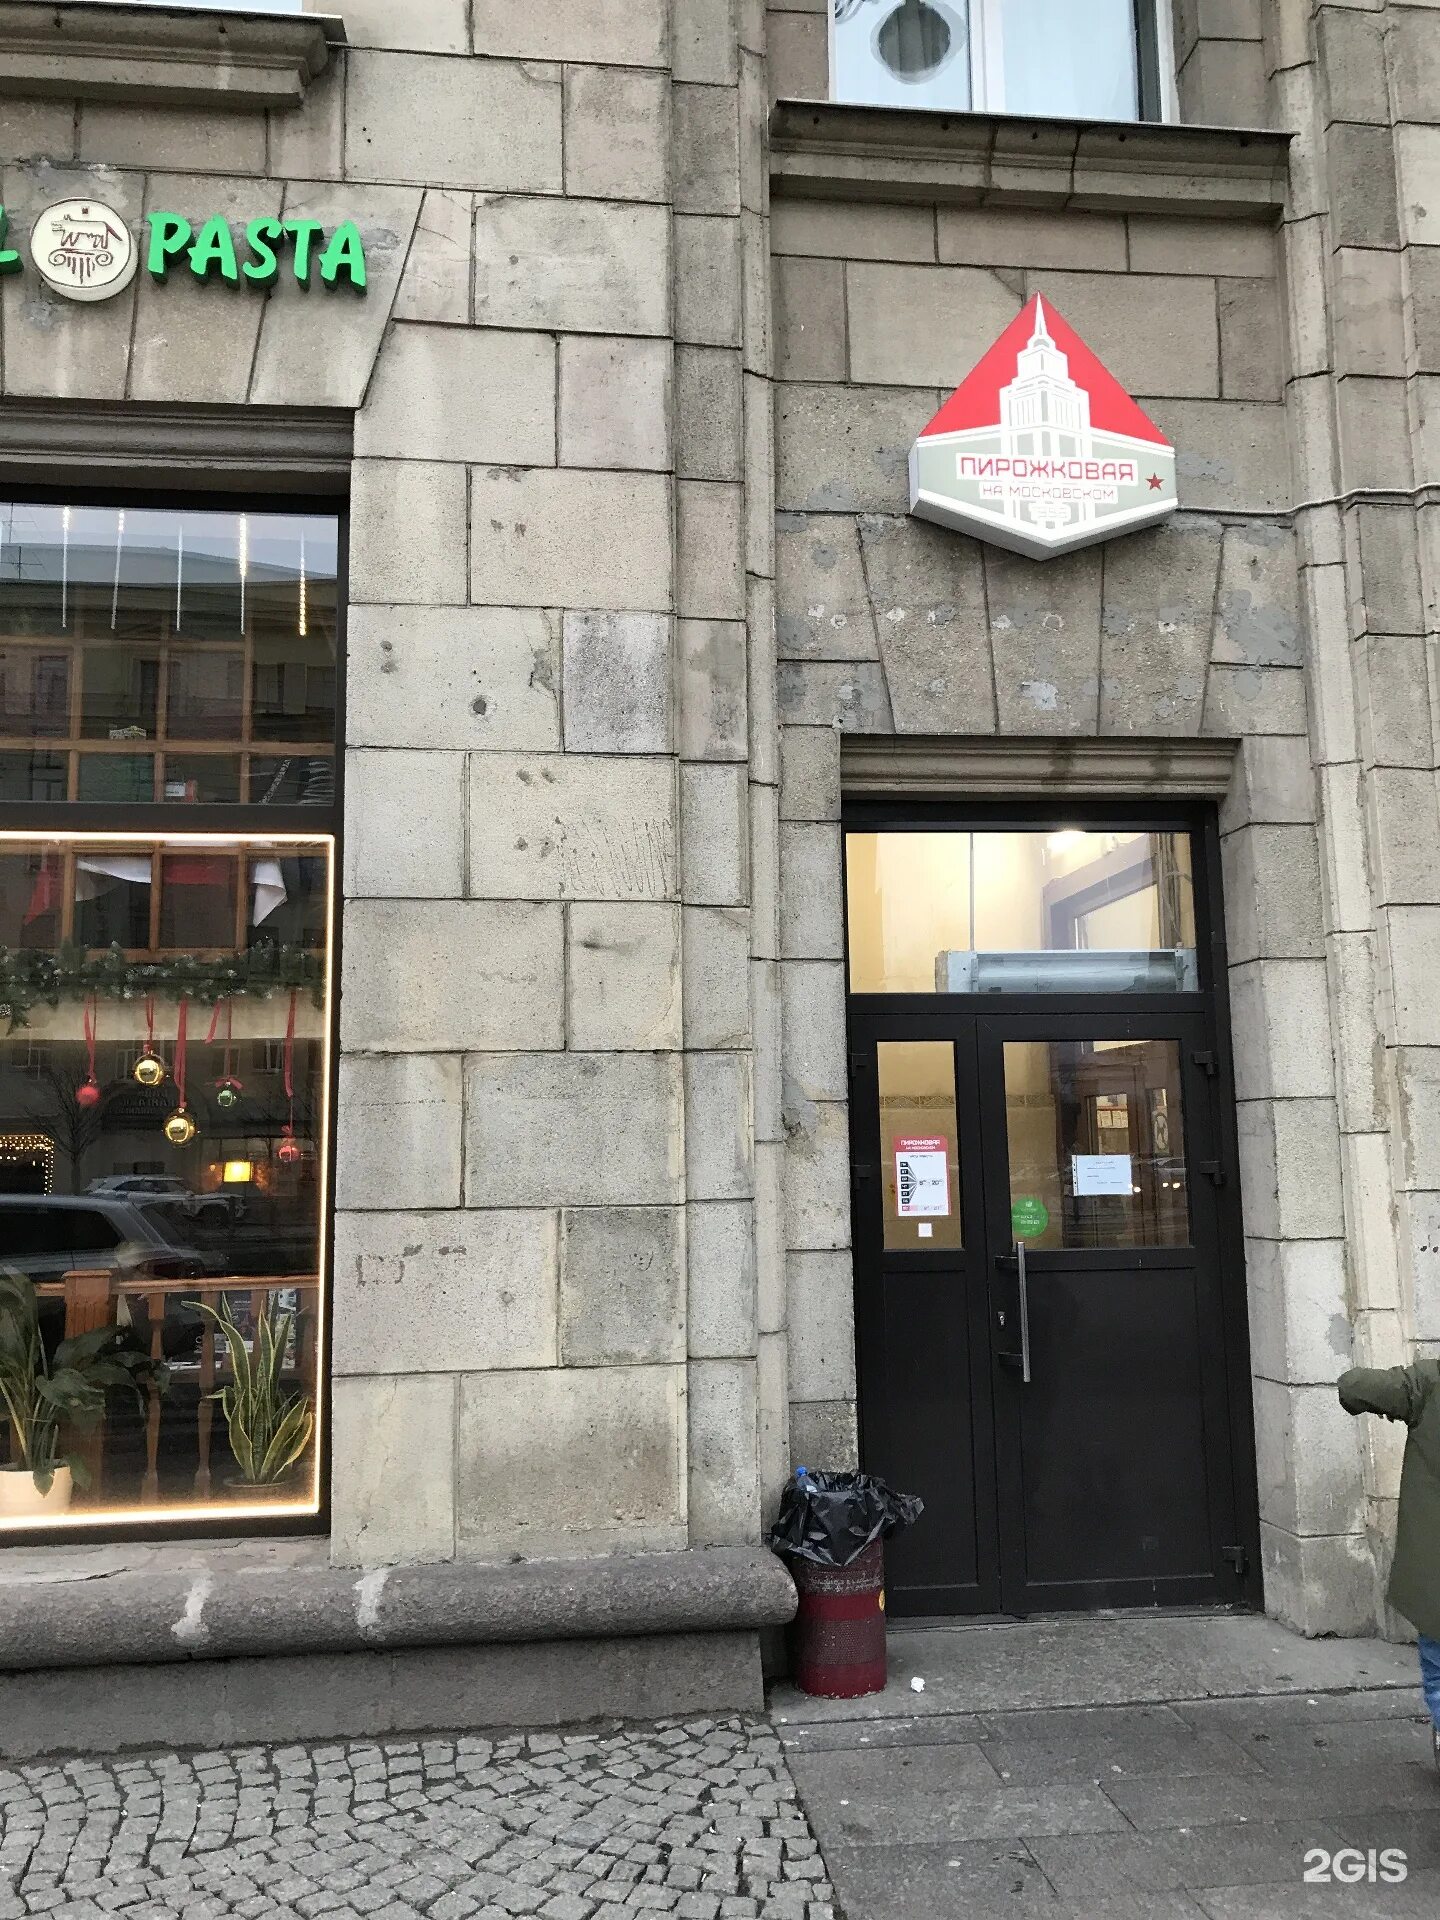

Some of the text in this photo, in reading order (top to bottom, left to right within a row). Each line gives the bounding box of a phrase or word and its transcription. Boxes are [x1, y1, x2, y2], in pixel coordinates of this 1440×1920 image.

[147, 210, 367, 290] PASTA
[960, 456, 1134, 481] ПИРОЖКОВАЯ
[983, 484, 1114, 500] НА МОСКОВСКОМ
